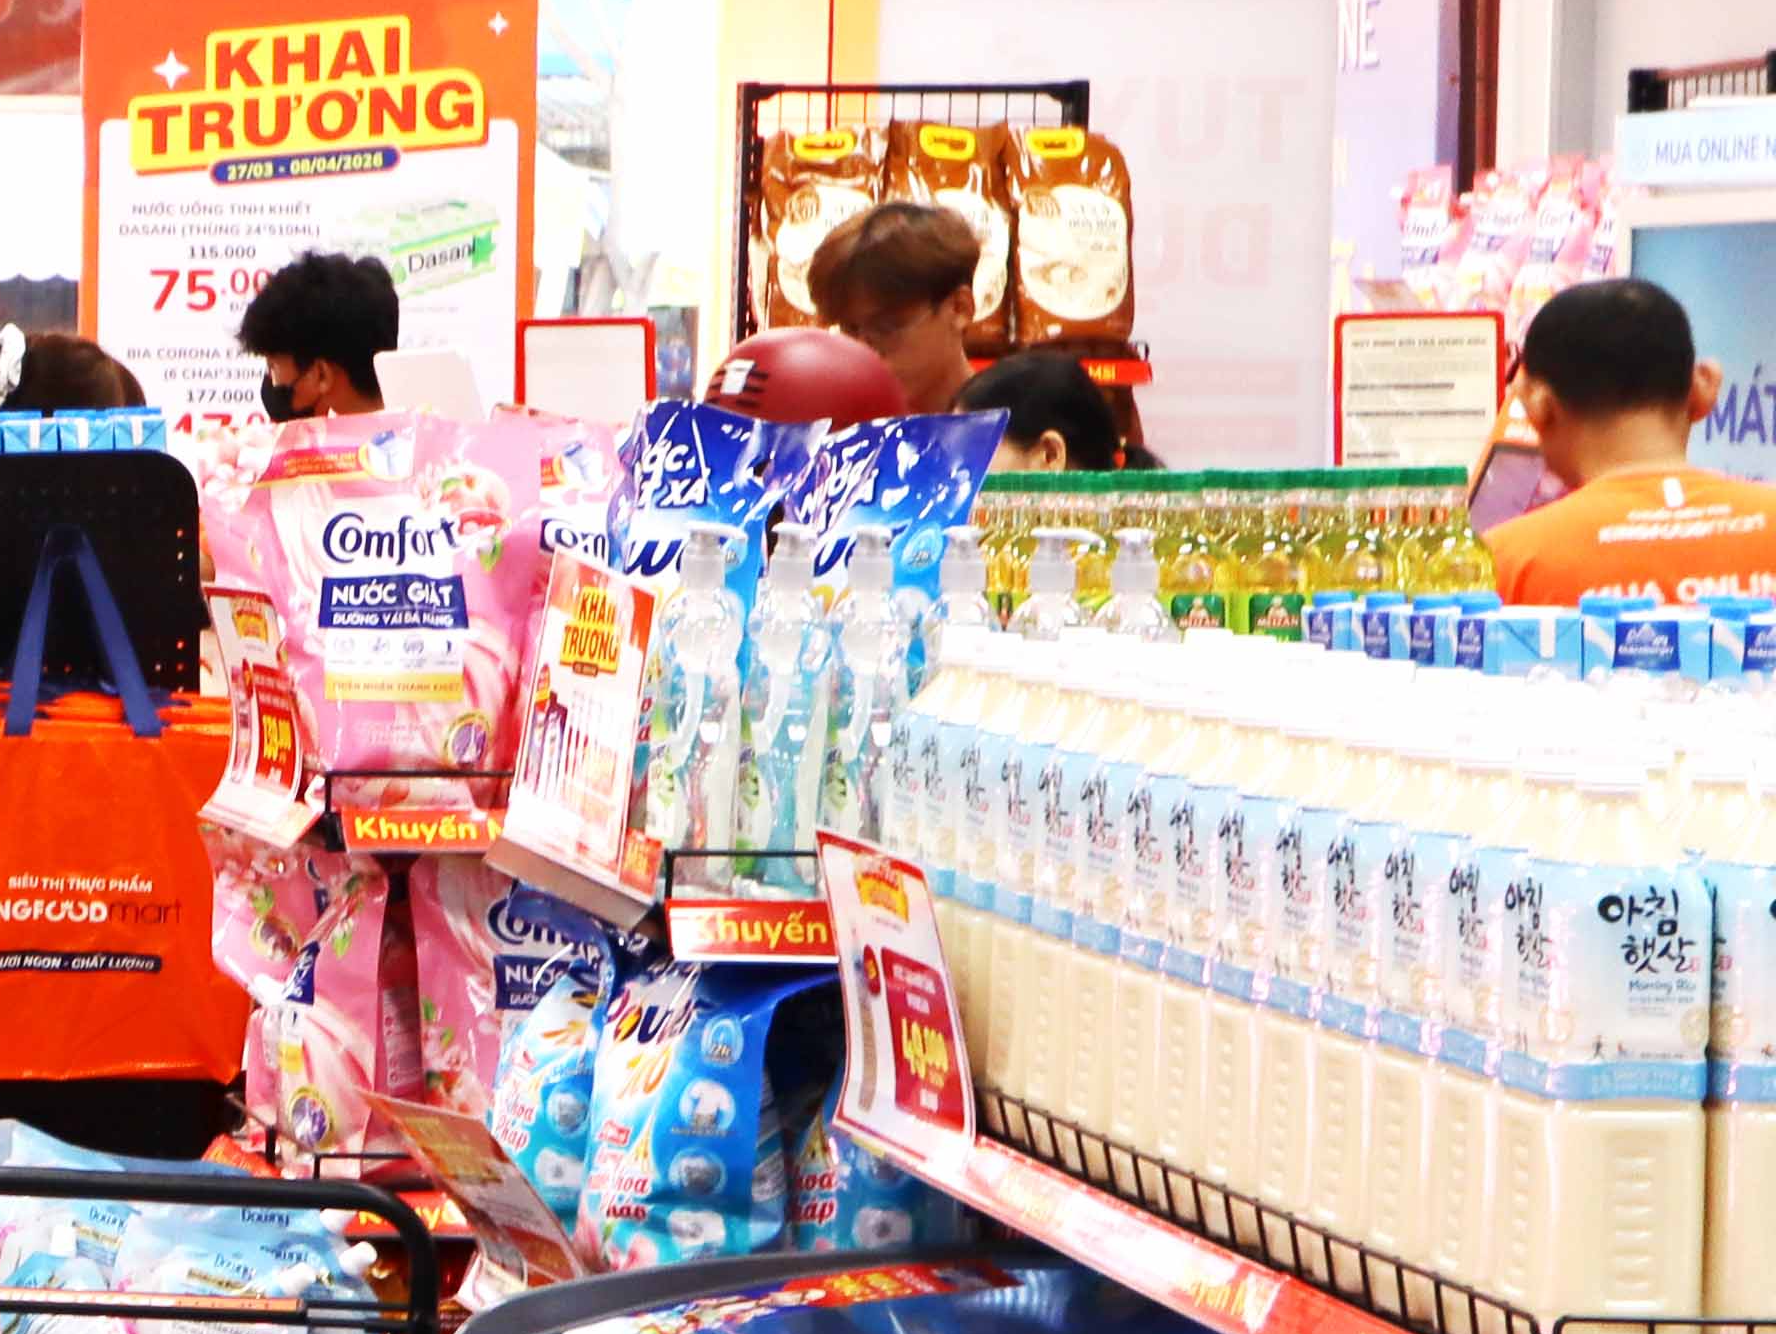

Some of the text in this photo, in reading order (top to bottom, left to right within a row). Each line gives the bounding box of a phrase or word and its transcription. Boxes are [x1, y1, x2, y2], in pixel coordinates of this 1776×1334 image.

[215, 27, 401, 90] KHAI
[137, 80, 475, 156] TRƯƠNG
[1656, 140, 1692, 164] MUA
[1697, 137, 1761, 163] ONLINE
[119, 223, 176, 237] DASANI
[187, 245, 256, 260] 115.000
[150, 268, 272, 312] 75.00
[157, 347, 221, 361] CORONA
[187, 389, 255, 404] 177.000
[323, 512, 456, 566] Comfort
[331, 583, 454, 609] NƯỚC GIẶT
[355, 814, 479, 844] Khuyến
[1598, 885, 1680, 937] 아침
[23, 954, 61, 970] NGON
[1620, 935, 1697, 974] 햇살
[89, 1205, 128, 1228] Down
